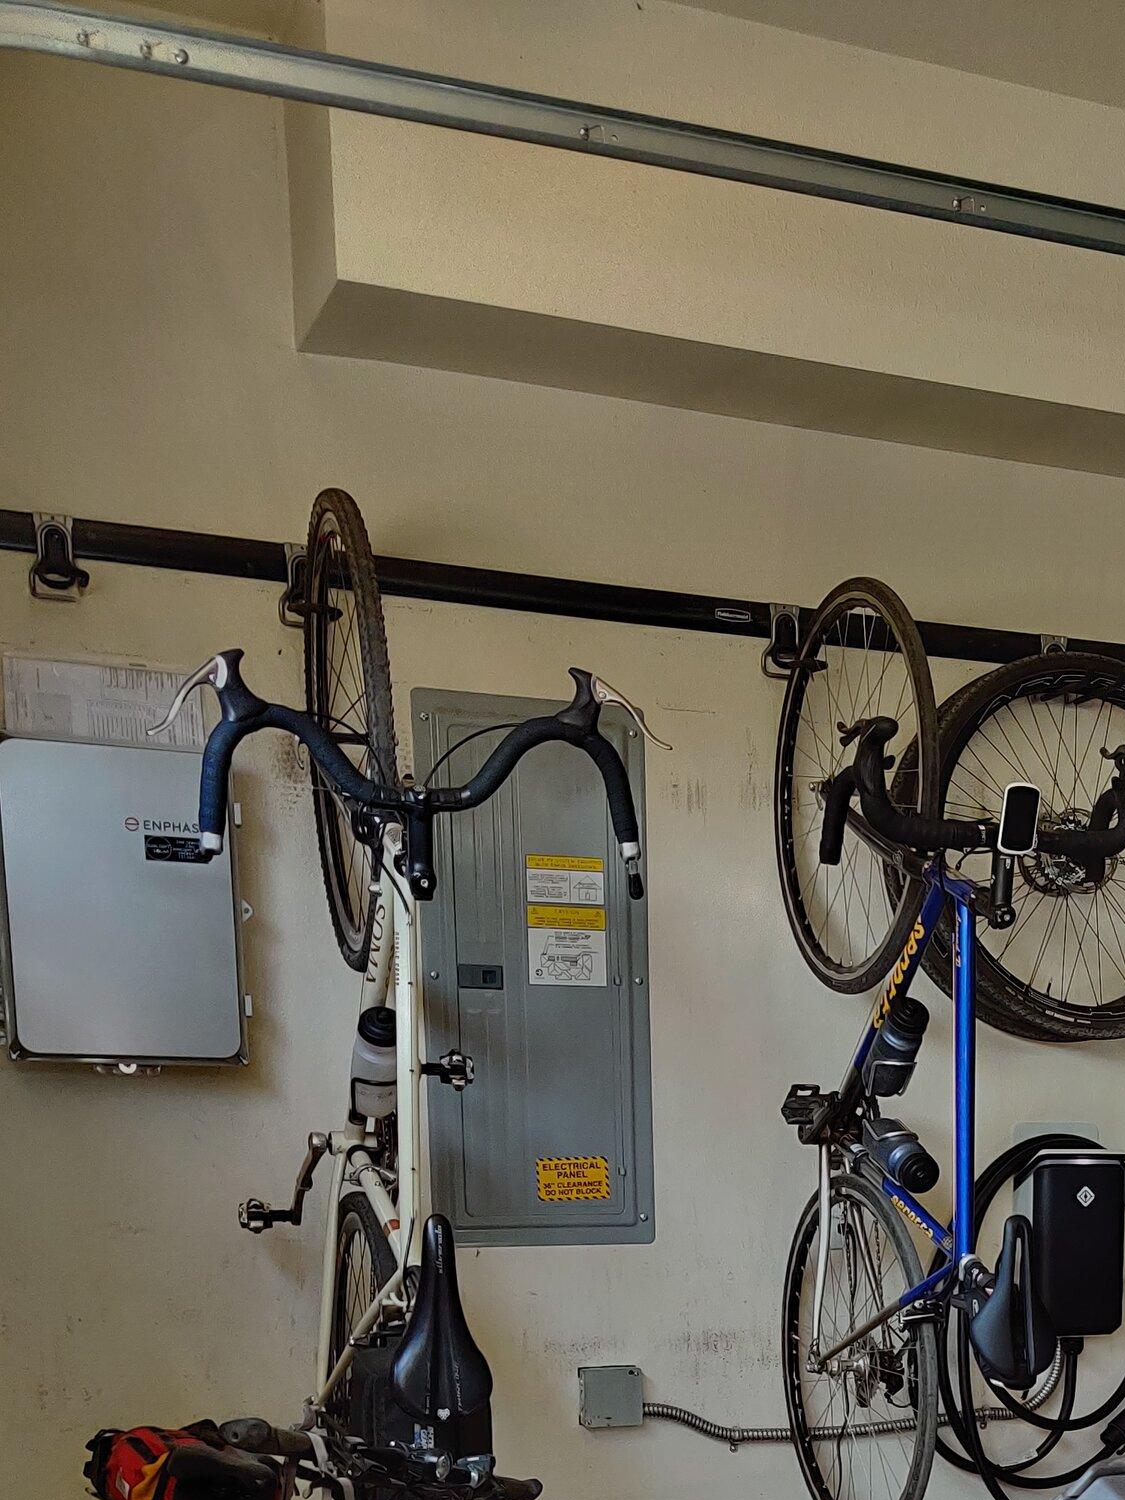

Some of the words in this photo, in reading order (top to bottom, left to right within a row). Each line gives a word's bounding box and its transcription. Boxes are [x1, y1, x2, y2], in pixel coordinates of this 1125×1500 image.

[143, 820, 200, 834] ENPHAS
[542, 1161, 602, 1171] ELECTRICAL
[557, 1170, 588, 1179] PANEL
[556, 1180, 603, 1189] CLEARANCE
[558, 1188, 574, 1196] NOT
[575, 1187, 602, 1195] BLOCK
